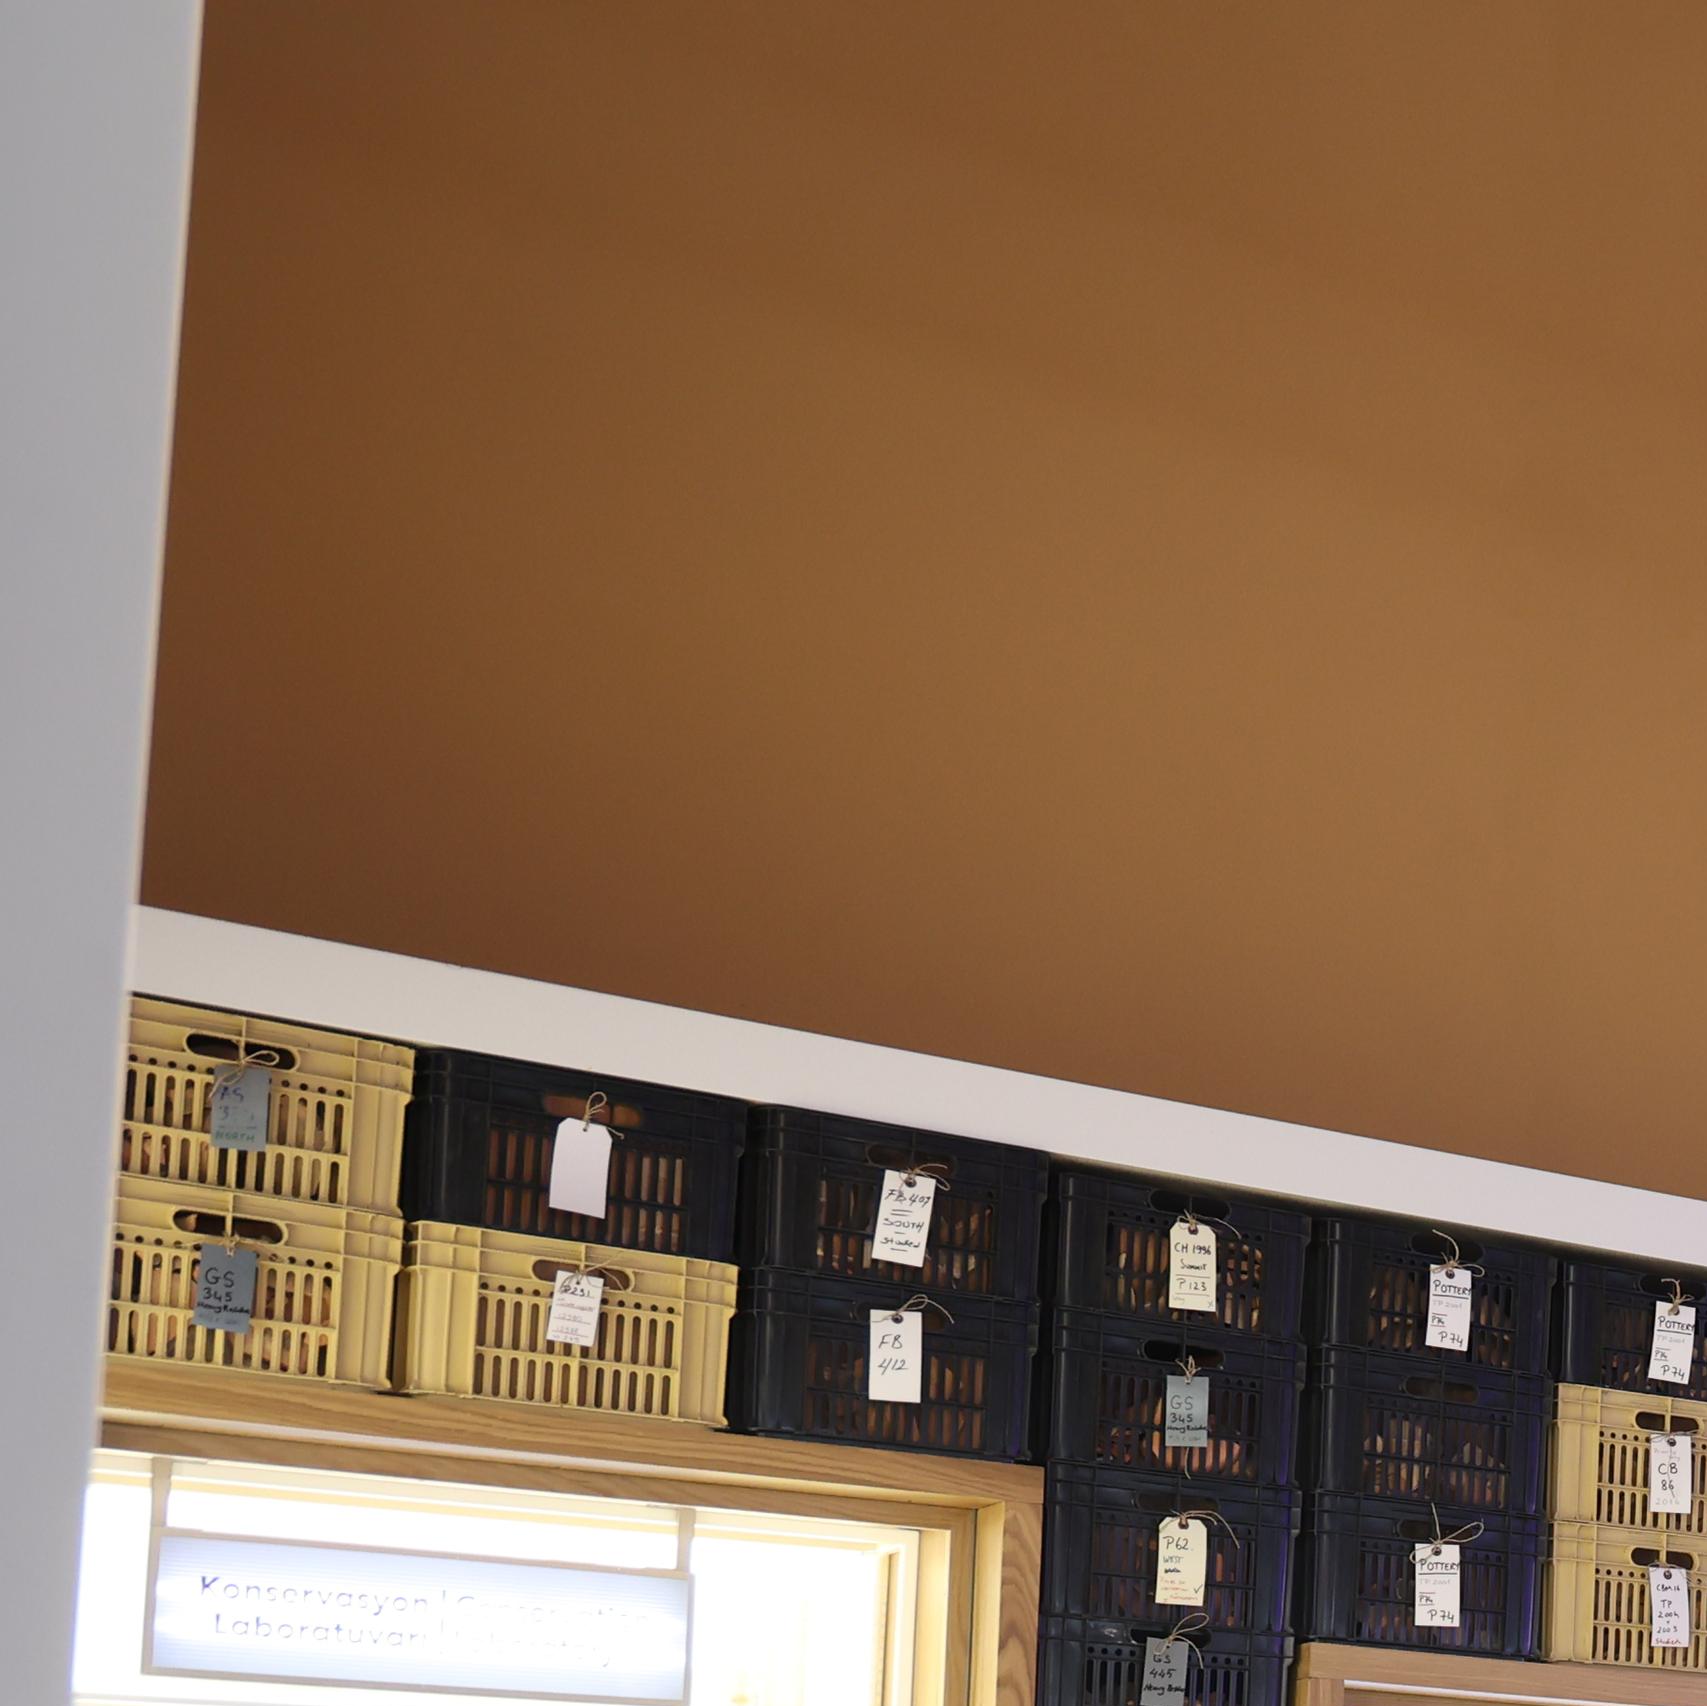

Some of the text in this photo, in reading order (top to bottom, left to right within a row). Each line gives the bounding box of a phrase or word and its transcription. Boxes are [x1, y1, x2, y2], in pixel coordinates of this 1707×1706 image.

[883, 1217, 925, 1233] SOUTH
[206, 1268, 234, 1286] GS
[878, 1334, 903, 1349] FB
[1170, 1395, 1193, 1410] GS
[1658, 1463, 1677, 1475] CB
[1152, 1653, 1170, 1664] GS
